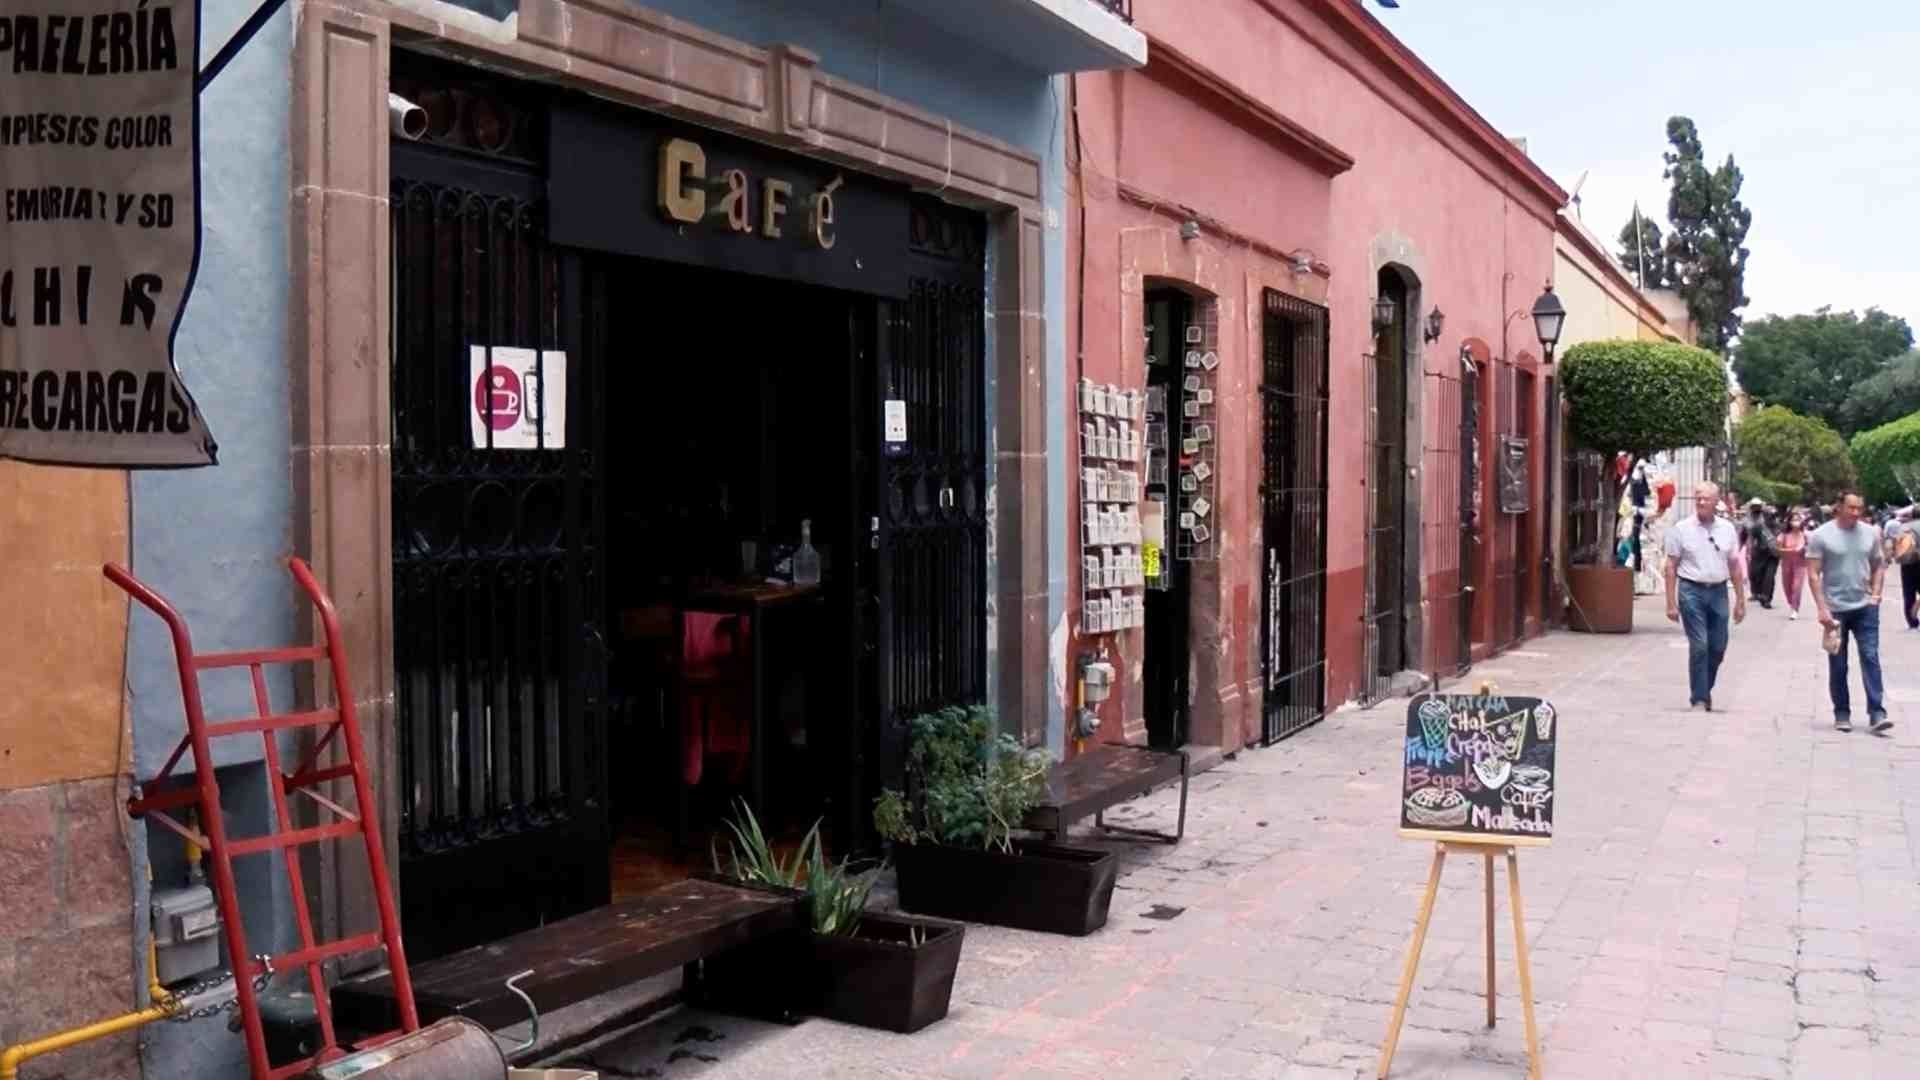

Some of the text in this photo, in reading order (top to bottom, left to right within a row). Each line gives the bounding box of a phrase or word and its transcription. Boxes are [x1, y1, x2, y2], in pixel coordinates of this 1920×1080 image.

[104, 114, 173, 149] COLOR
[115, 193, 135, 225] Y
[138, 193, 174, 229] SD
[0, 370, 190, 434] RECARGAS
